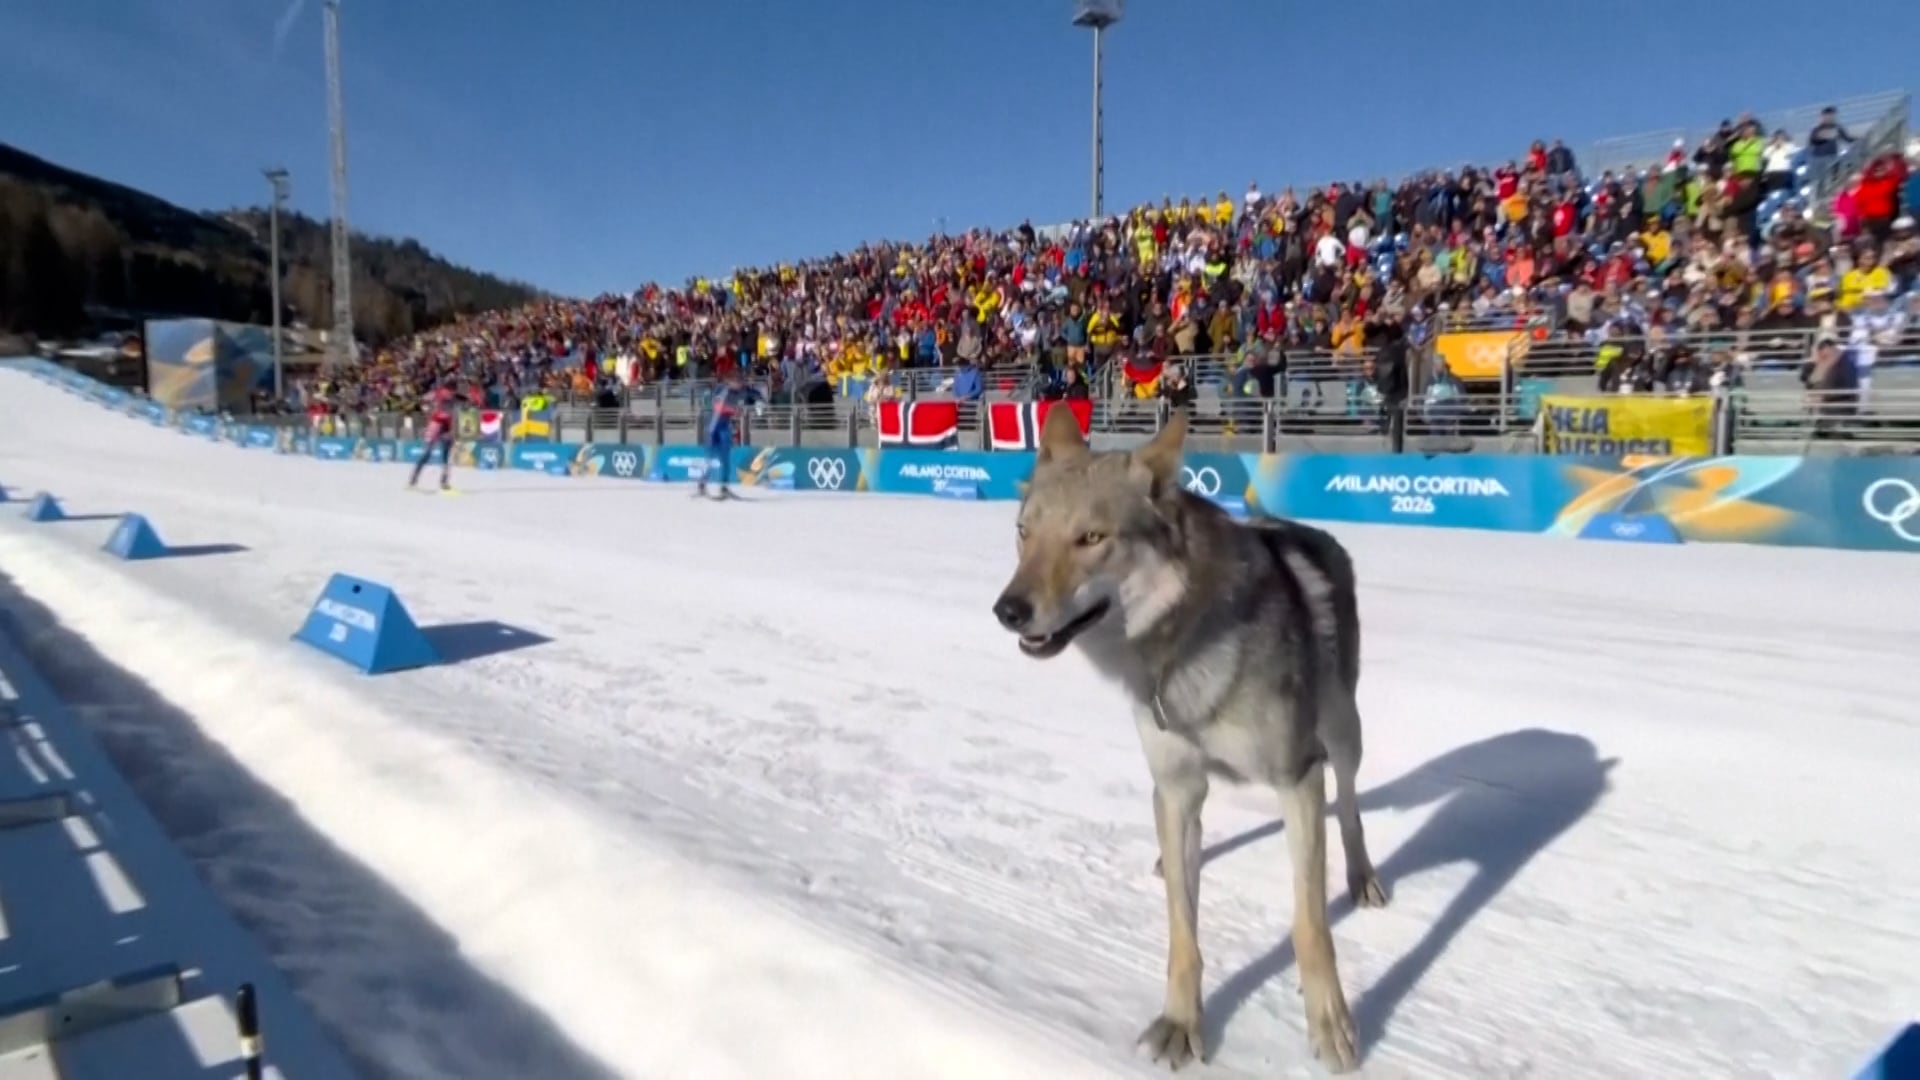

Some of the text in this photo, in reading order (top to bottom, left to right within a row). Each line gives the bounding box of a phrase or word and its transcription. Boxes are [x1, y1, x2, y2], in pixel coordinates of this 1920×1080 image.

[1325, 475, 1509, 496] MILANO CORTINA
[1391, 496, 1435, 514] 2026
